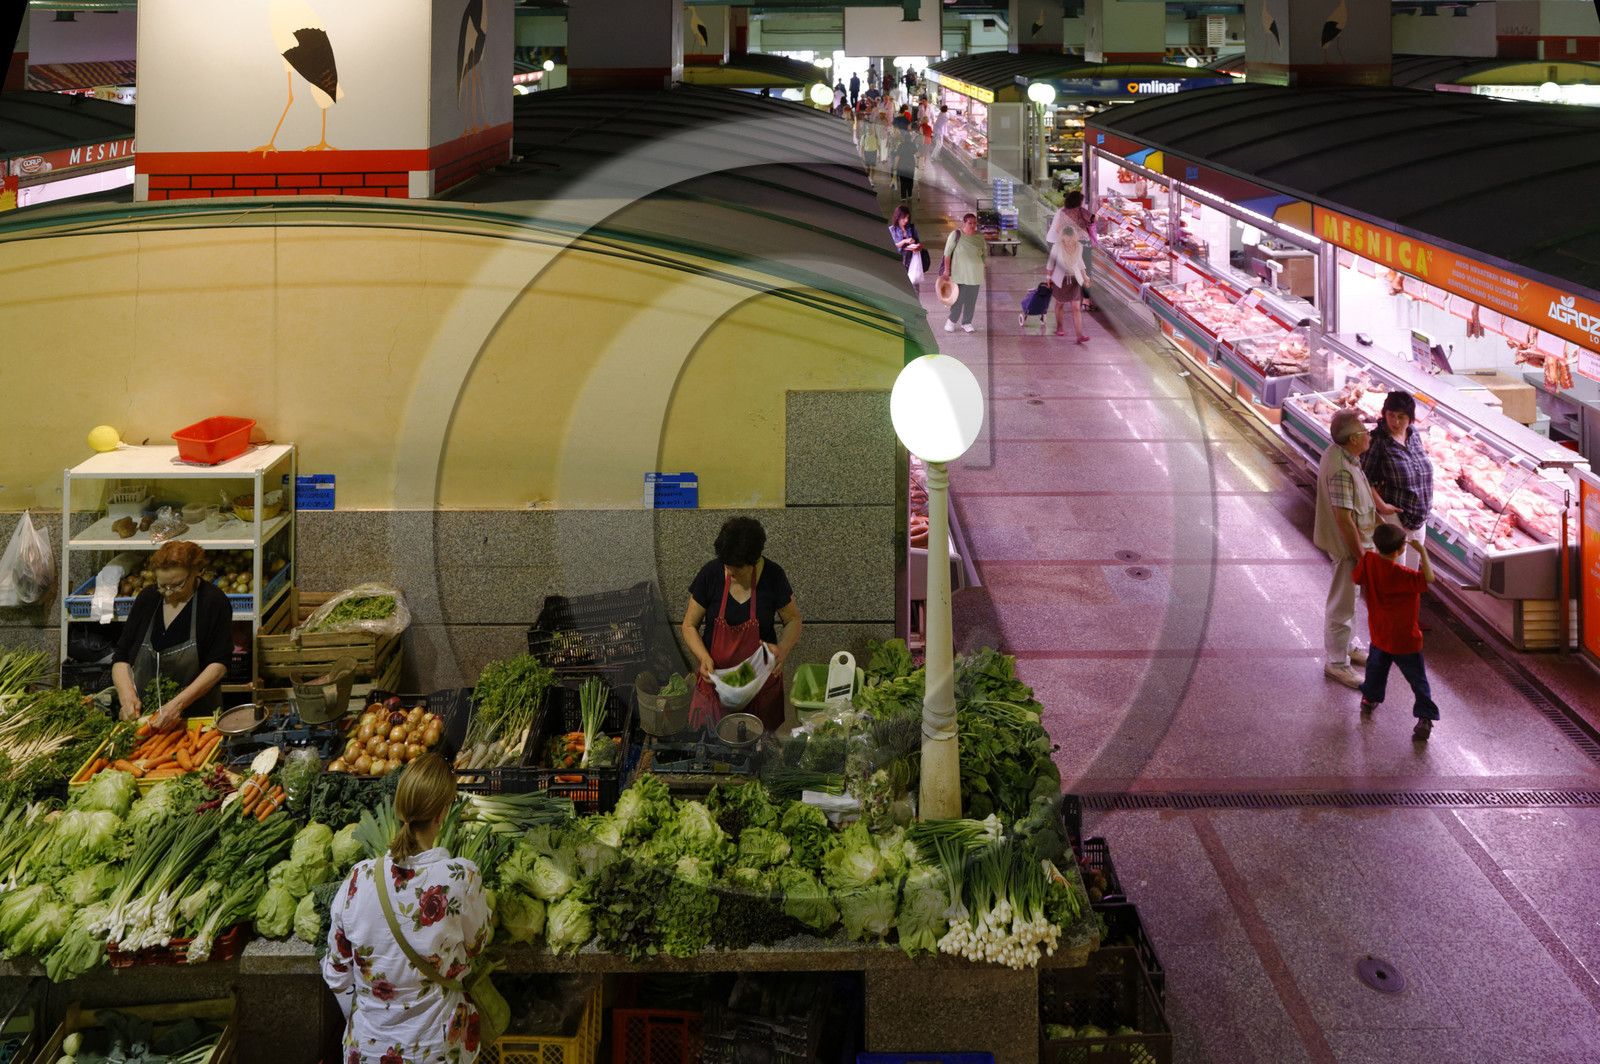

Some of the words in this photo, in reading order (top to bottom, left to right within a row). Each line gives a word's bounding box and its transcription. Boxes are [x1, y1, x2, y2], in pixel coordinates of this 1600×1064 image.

[1138, 80, 1181, 94] mlinar
[1324, 214, 1428, 277] MESNICA
[1487, 293, 1519, 311] PORIJEKLO
